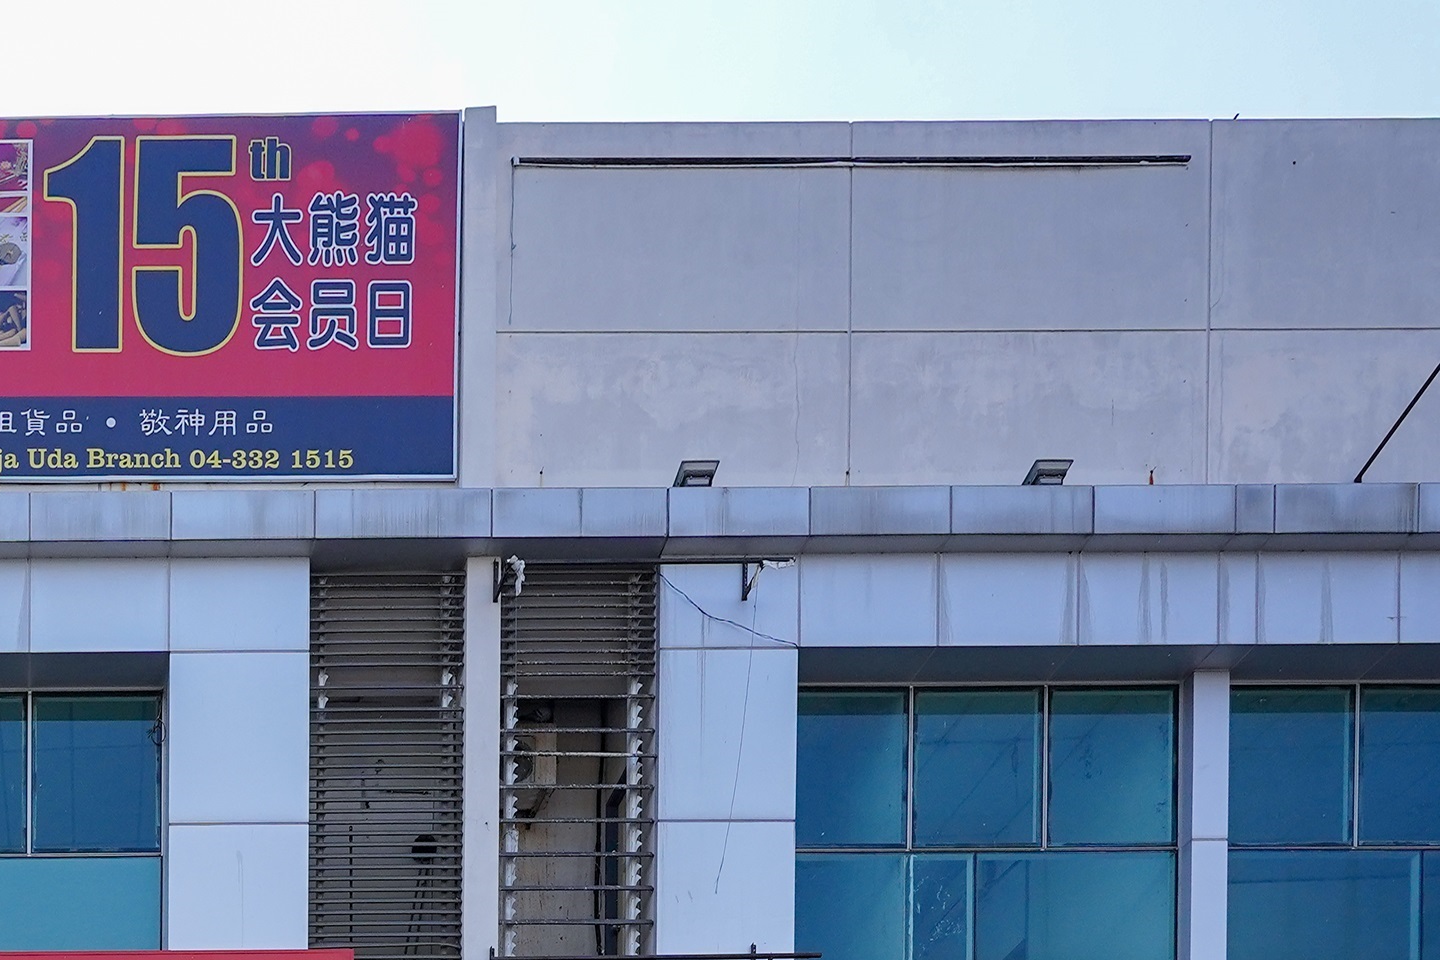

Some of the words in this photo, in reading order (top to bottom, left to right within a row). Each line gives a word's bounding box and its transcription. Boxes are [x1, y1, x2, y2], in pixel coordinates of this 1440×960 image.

[251, 191, 418, 267] 大熊猫
[251, 278, 412, 352] 会员日
[138, 408, 275, 437] 敬神用品
[28, 448, 79, 470] Uda
[86, 448, 180, 469] Branch
[189, 448, 279, 470] 04-332
[291, 448, 354, 469] 1515
